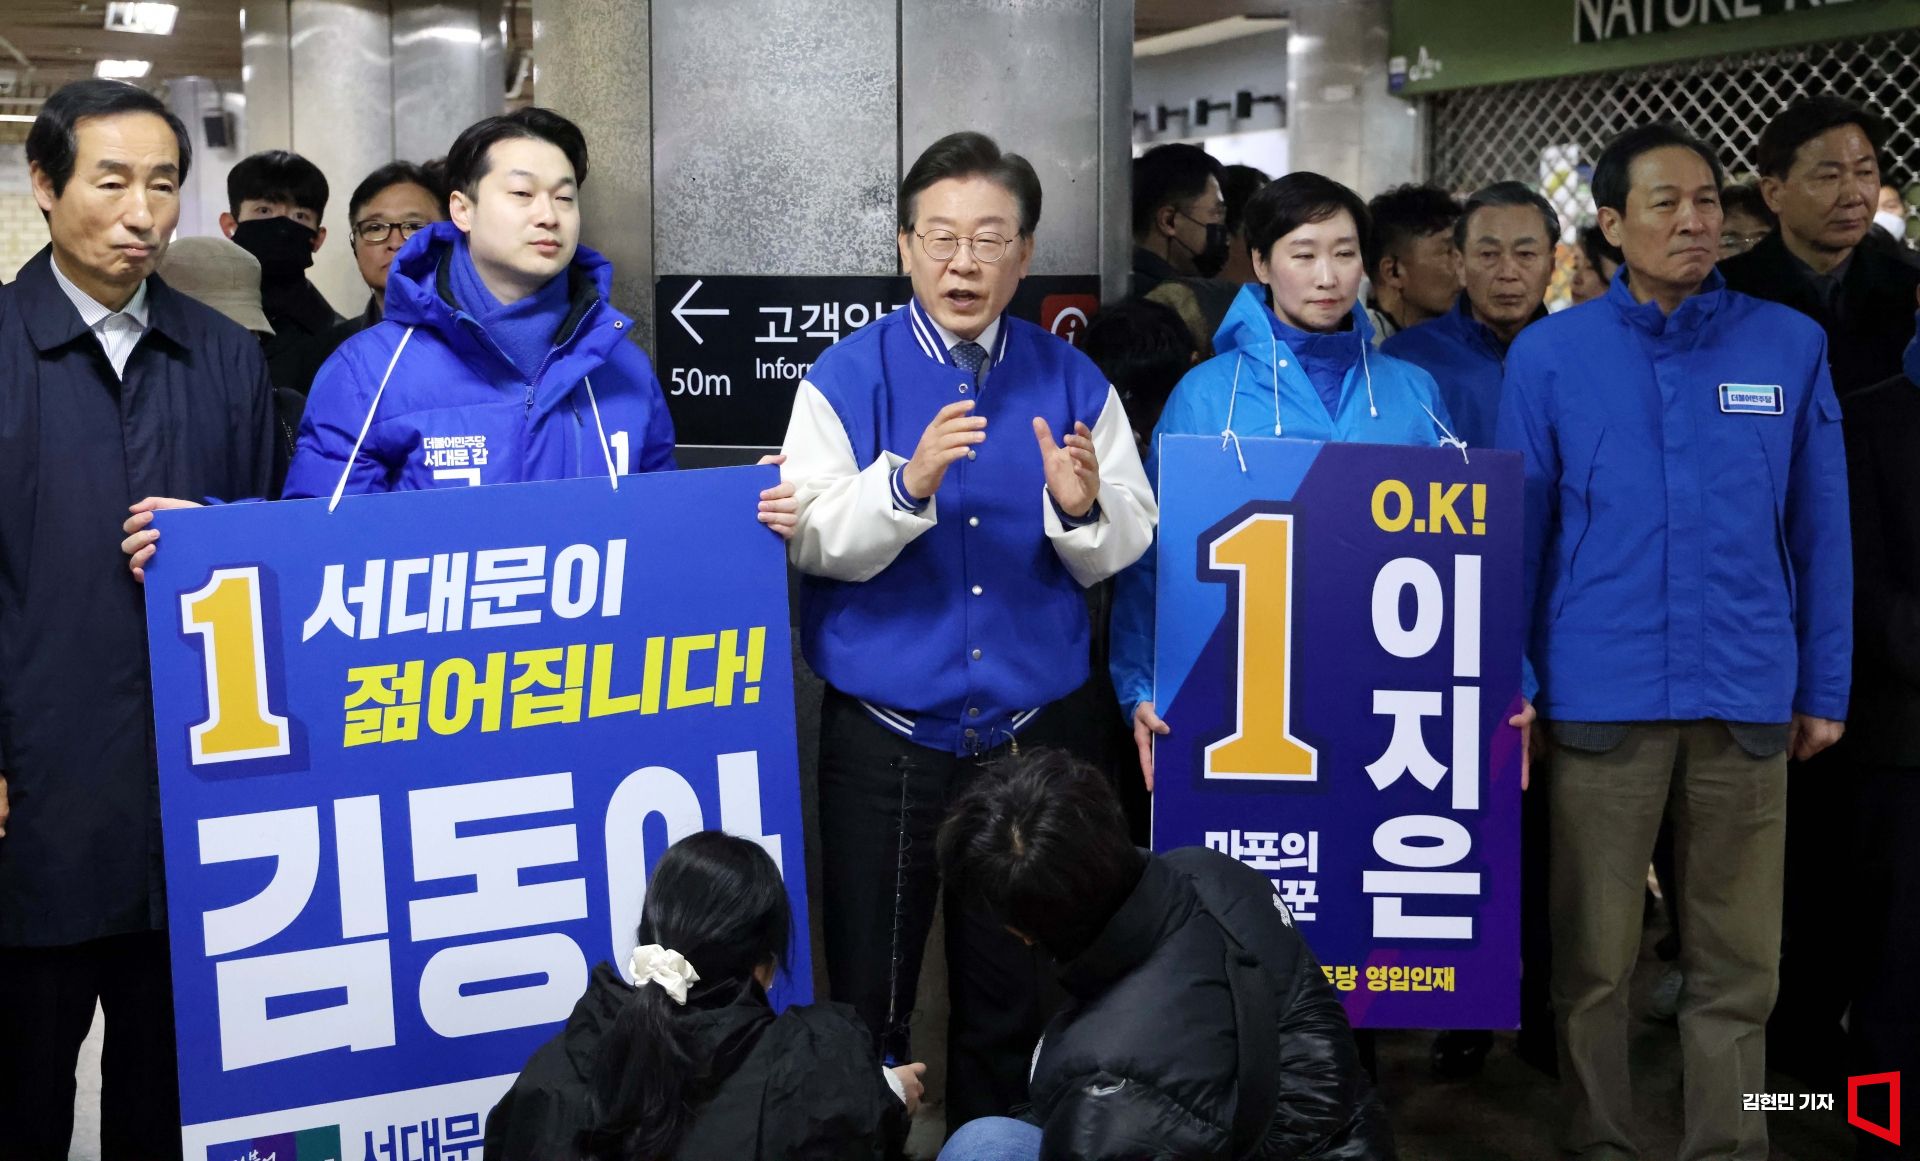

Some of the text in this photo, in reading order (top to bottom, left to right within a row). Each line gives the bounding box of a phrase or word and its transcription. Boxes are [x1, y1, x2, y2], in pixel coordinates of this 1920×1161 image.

[755, 302, 907, 345] 고객안
[670, 368, 731, 396] 50m
[1731, 394, 1772, 404] 더불어민주당
[423, 435, 486, 449] 더불어민주당
[424, 448, 488, 467] 서대문 갑
[611, 431, 629, 475] 1
[1371, 479, 1487, 535] O.K!
[302, 539, 627, 643] 서대문이
[181, 566, 290, 765] 1
[1204, 513, 1318, 781] 1
[343, 626, 766, 748] 젊어집니다!
[1362, 553, 1482, 939] 이지은
[1205, 829, 1318, 873] 마포의
[1271, 879, 1319, 921] 꾼
[1365, 965, 1455, 992] 영입인재
